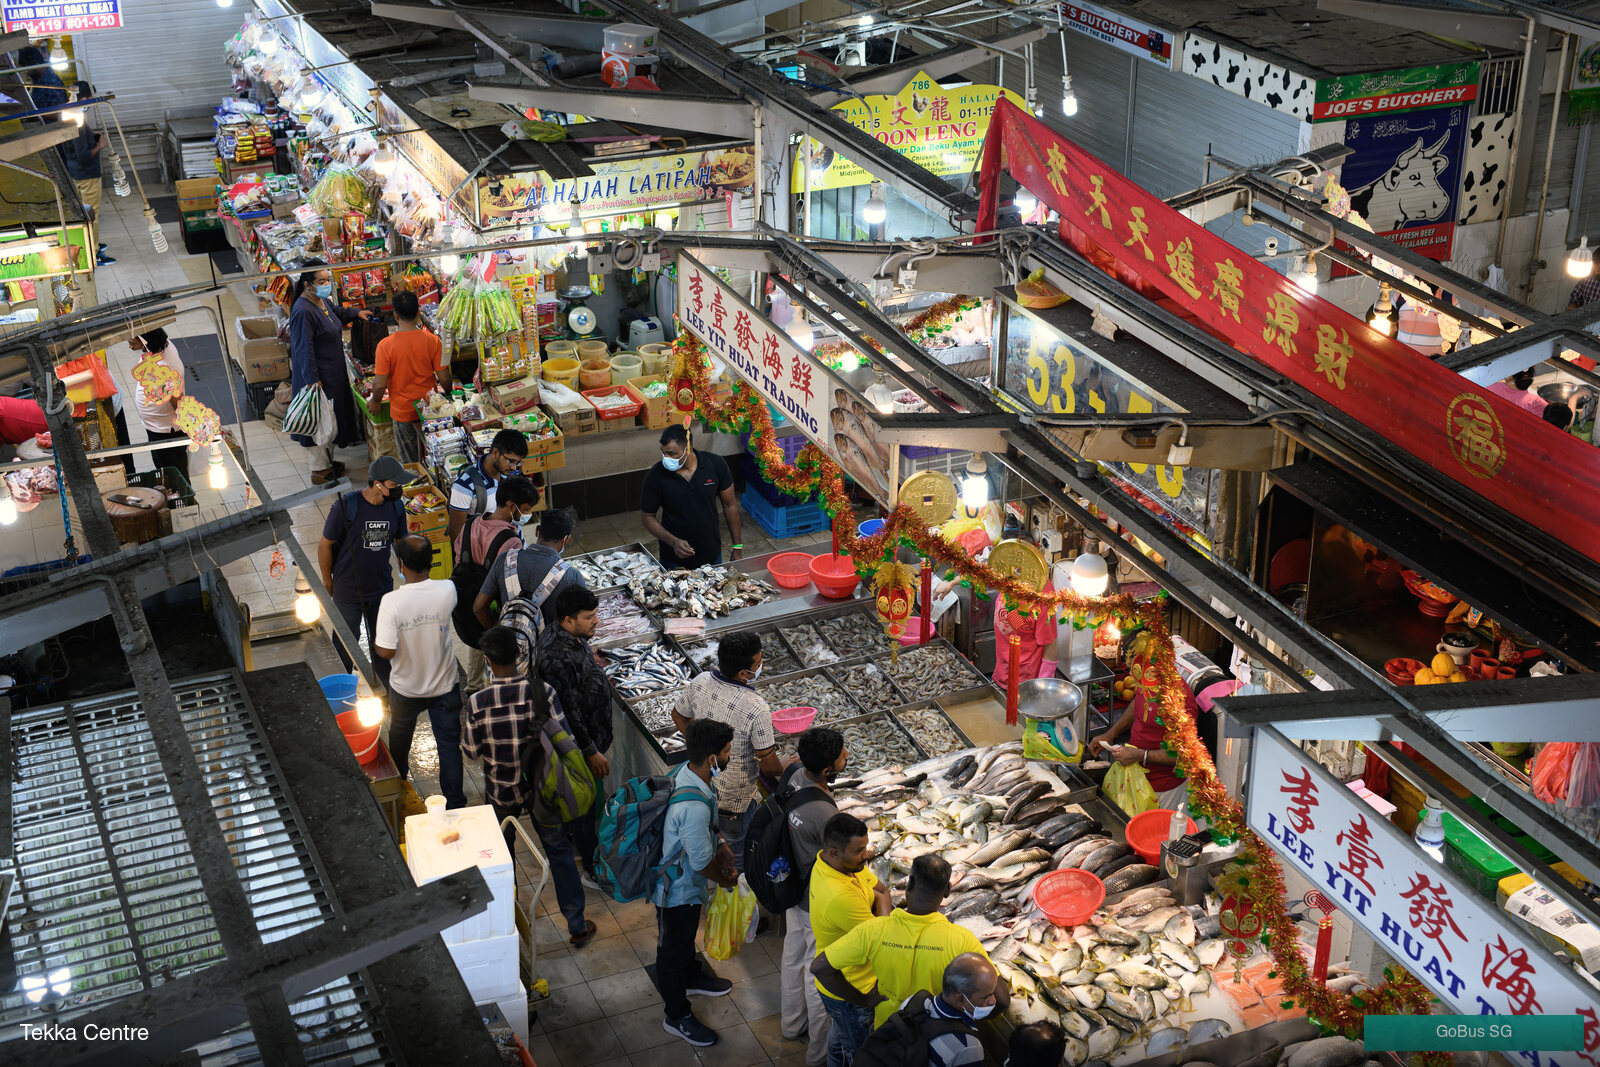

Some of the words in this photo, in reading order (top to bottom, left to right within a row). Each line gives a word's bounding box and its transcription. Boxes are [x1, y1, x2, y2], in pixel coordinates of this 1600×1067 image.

[8, 8, 34, 19] LAMB
[36, 6, 60, 16] MEAT
[64, 4, 88, 15] GOAT
[89, 2, 114, 13] MEAT
[1069, 21, 1089, 34] EXPECT
[1089, 27, 1100, 38] THE
[1101, 33, 1115, 43] BEST
[1080, 11, 1141, 43] BUTCHERY
[912, 80, 930, 91] 786
[960, 93, 997, 104] HALAL
[1324, 100, 1373, 116] JOE'S
[1377, 88, 1466, 110] BUTCHERY
[924, 121, 977, 142] LENG
[910, 145, 927, 153] Dan
[929, 142, 950, 152] Beku
[952, 139, 975, 150] Ayam
[525, 176, 618, 208] ALHAJAH
[629, 165, 713, 194] LATIFAH
[636, 194, 667, 203] Wholesale
[1400, 230, 1420, 241] FRESH
[1421, 227, 1436, 237] BEEF
[1402, 239, 1429, 248] ZEALAND
[1435, 235, 1448, 244] USA
[688, 268, 815, 409] 李壹發海鮮
[686, 307, 705, 335] LEE
[707, 325, 726, 352] YIT
[729, 344, 760, 382] HUAT
[763, 374, 818, 434] TRADING
[1453, 404, 1501, 471] 福
[1267, 812, 1314, 869] LEE
[1324, 861, 1372, 917] YIT
[1379, 912, 1466, 999] HUAT
